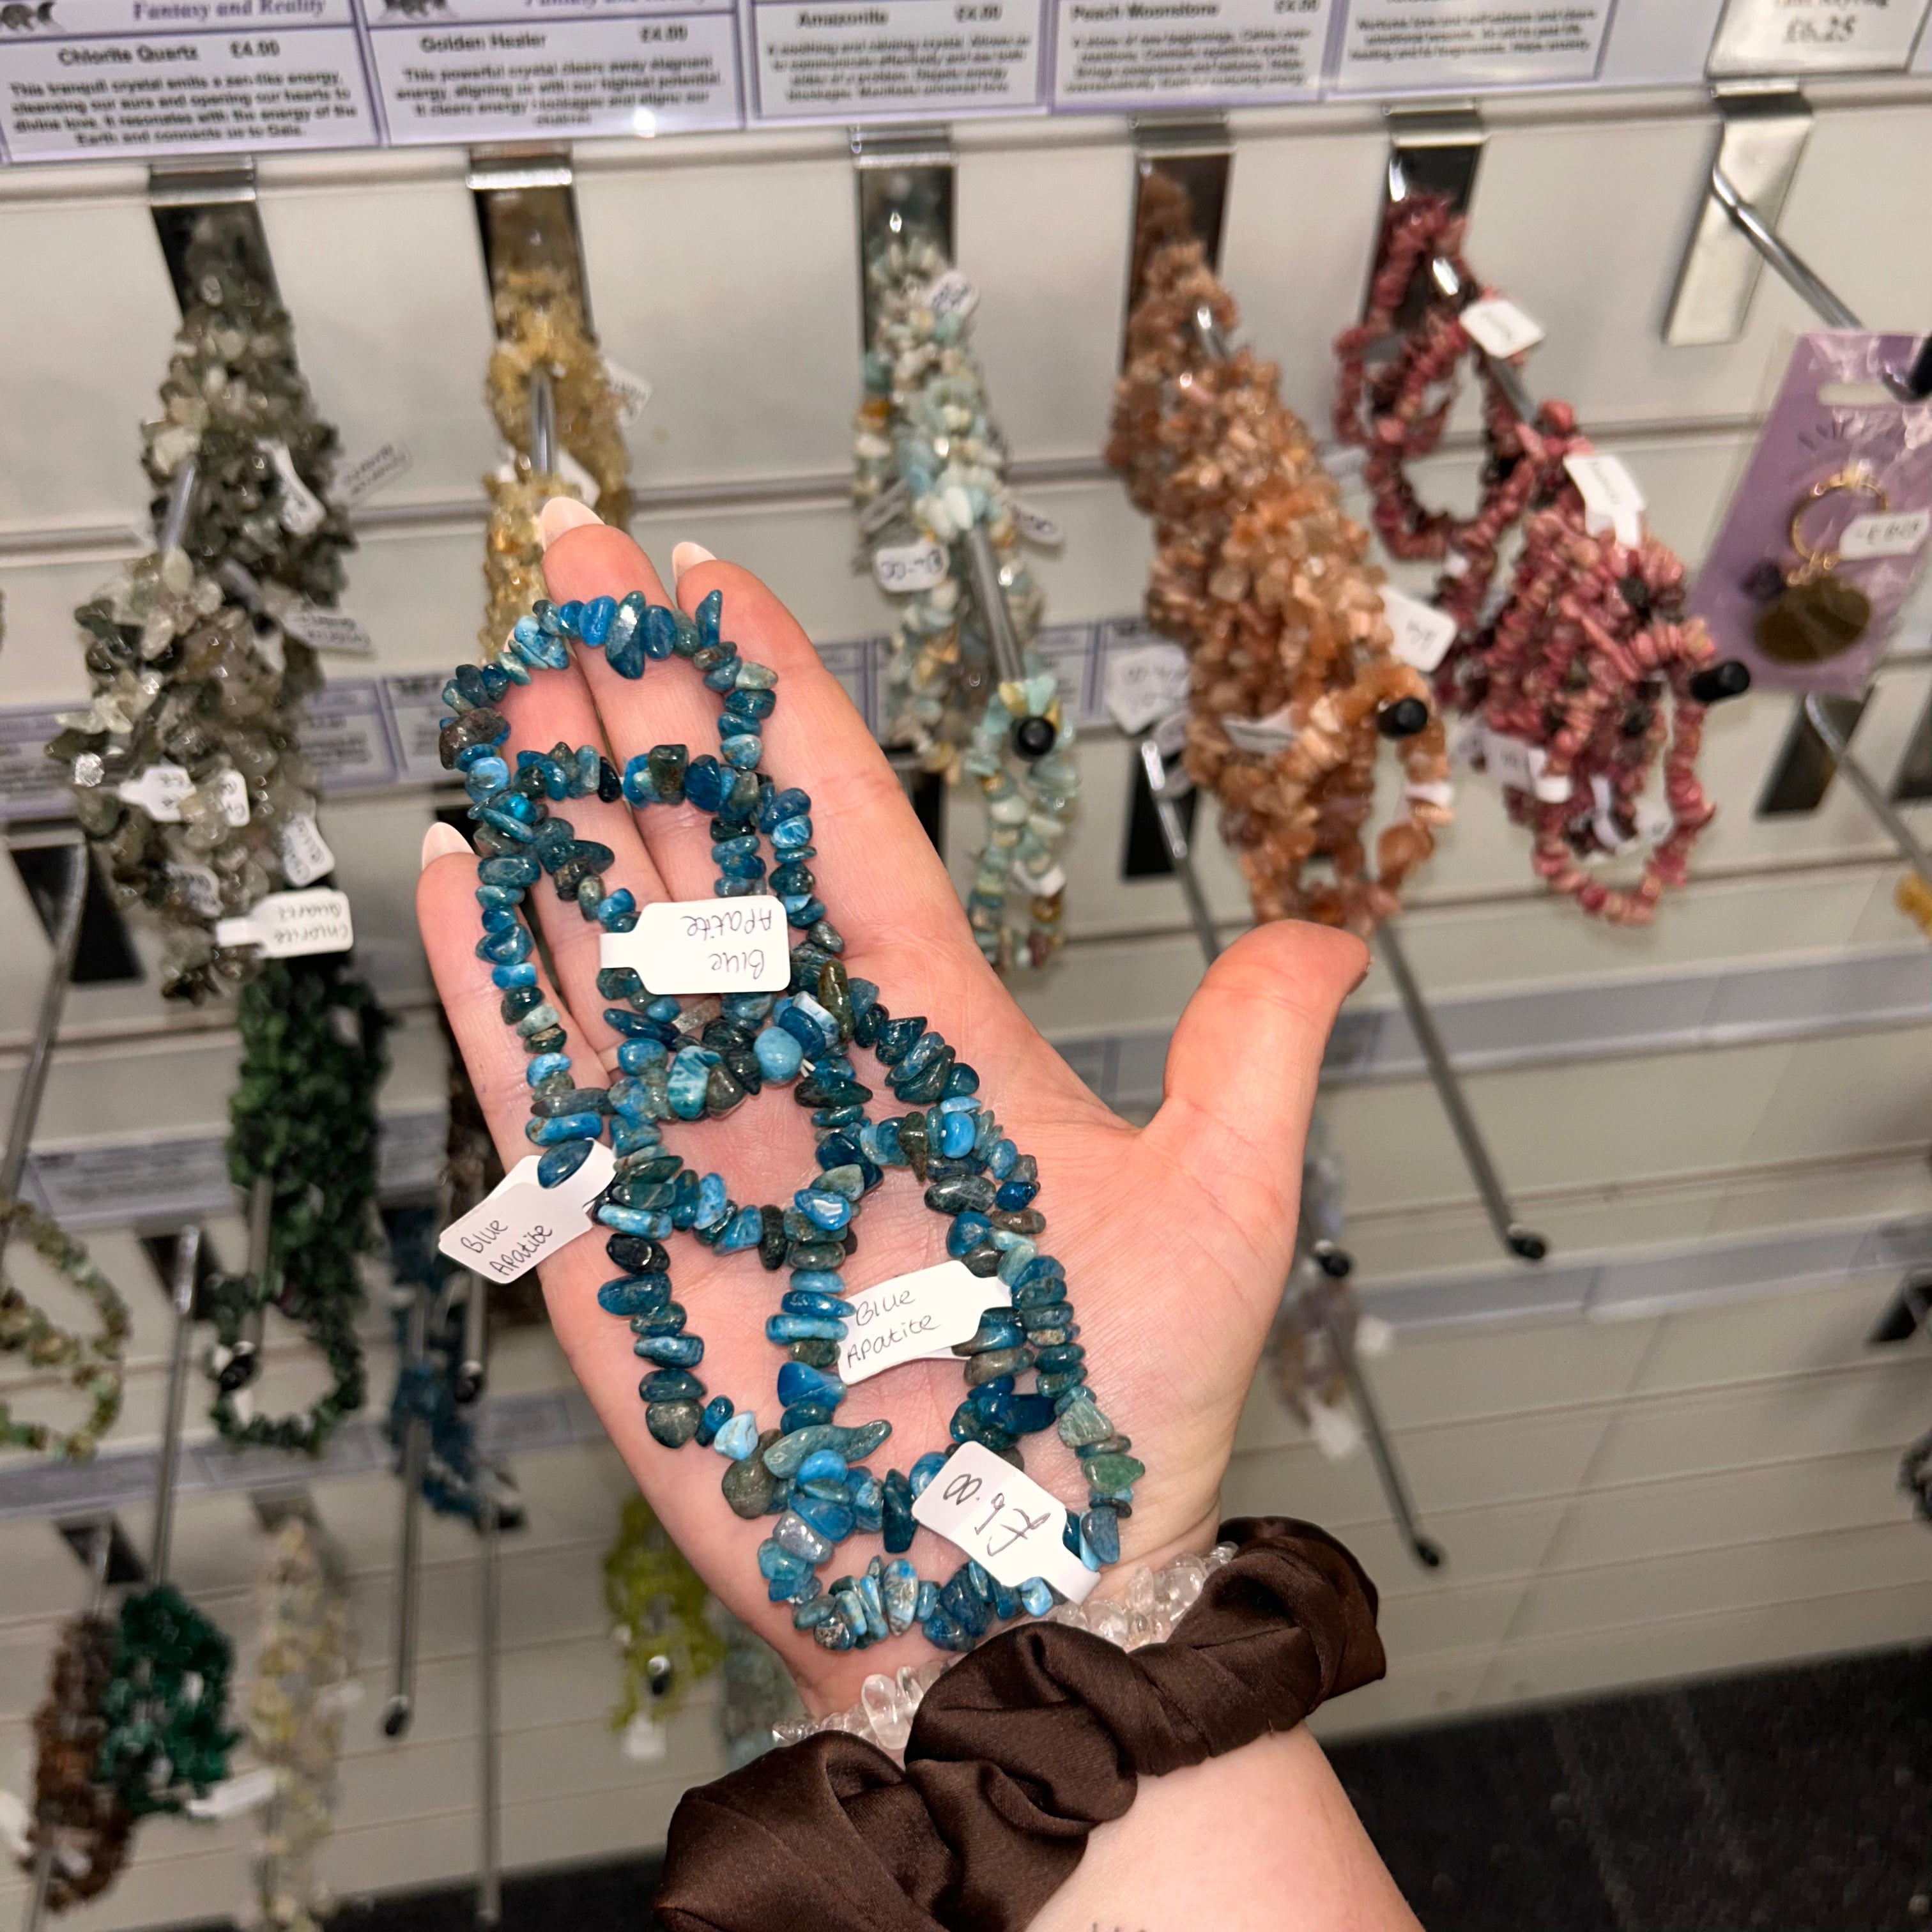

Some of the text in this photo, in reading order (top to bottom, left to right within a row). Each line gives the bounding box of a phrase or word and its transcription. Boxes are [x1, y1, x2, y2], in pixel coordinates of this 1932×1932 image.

[133, 1, 210, 21] Fantasy
[216, 1, 252, 16] and
[58, 39, 280, 65] Chlorite Quartz £4.00
[419, 34, 486, 53] Golden
[488, 31, 546, 50] Healer
